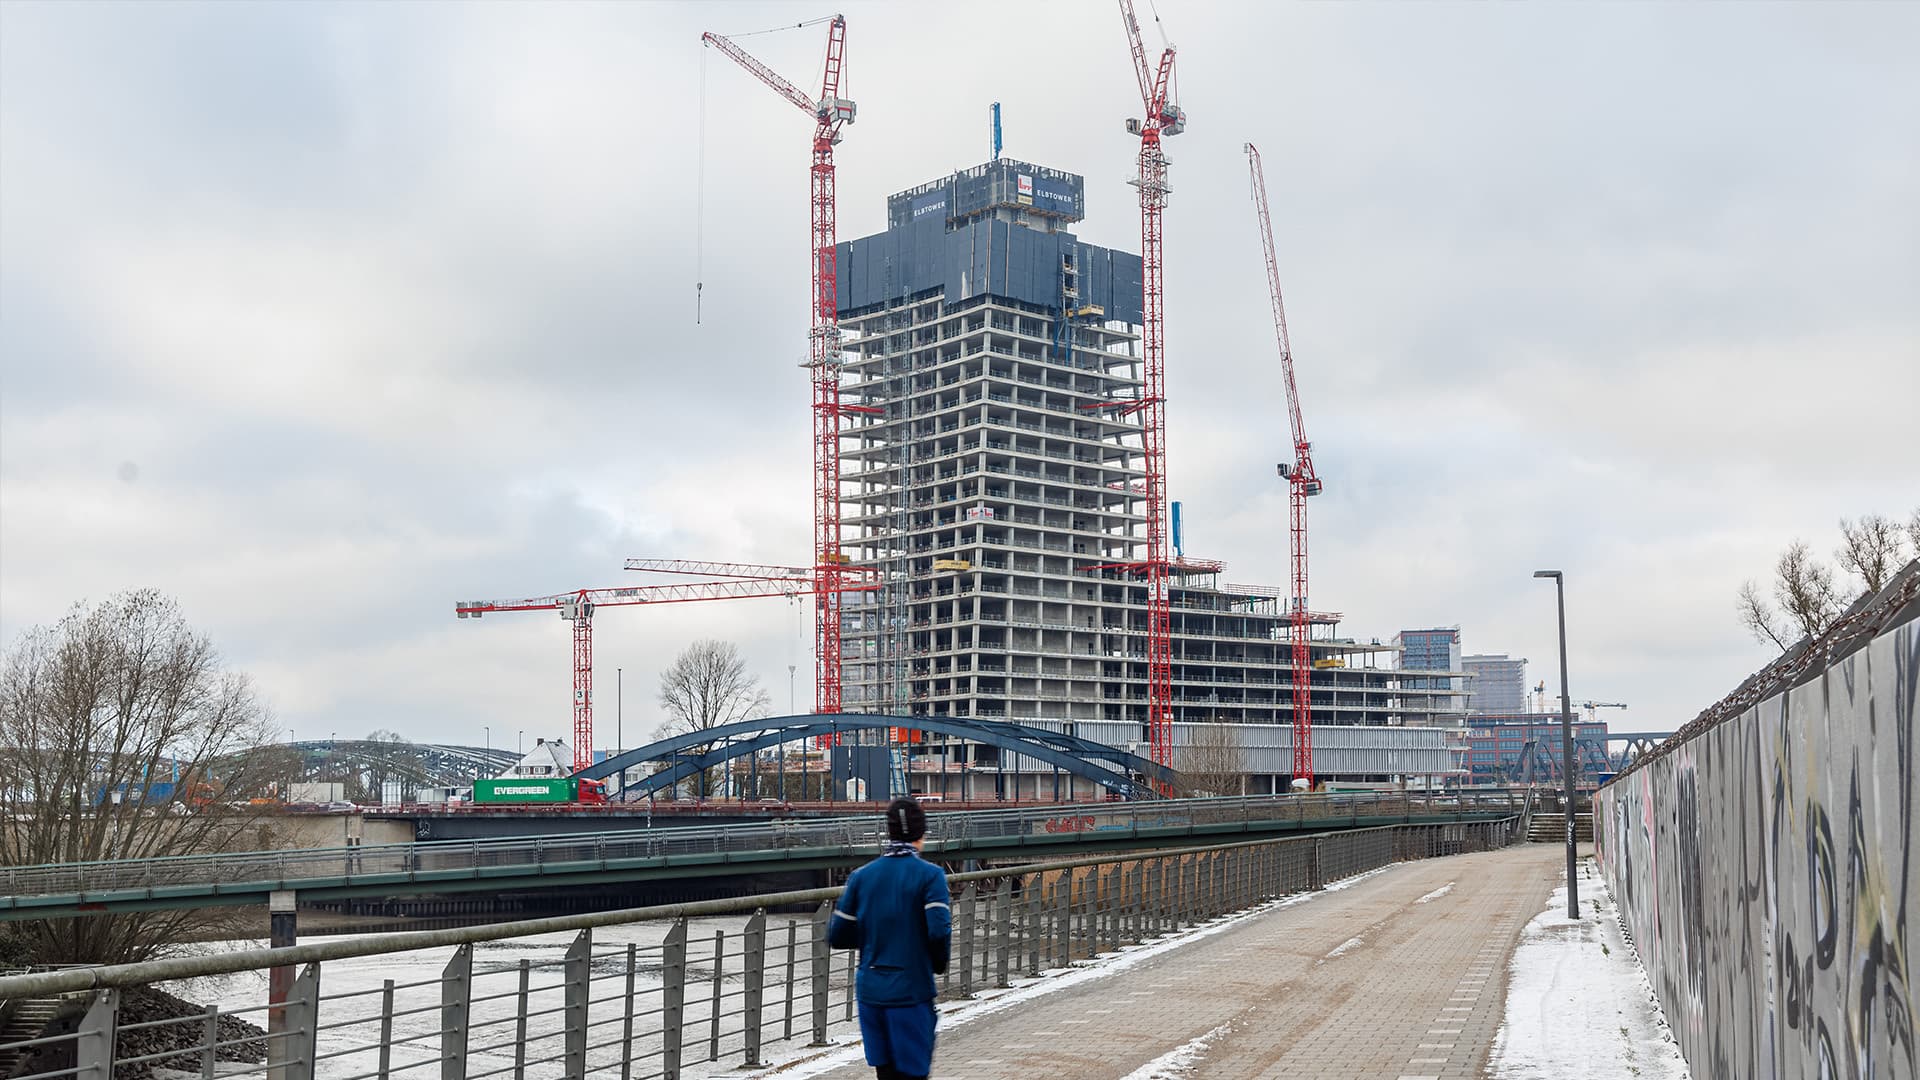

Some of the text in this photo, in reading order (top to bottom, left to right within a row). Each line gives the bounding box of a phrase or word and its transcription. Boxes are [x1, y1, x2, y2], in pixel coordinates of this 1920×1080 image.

[1037, 189, 1073, 203] ELBTOWER
[914, 201, 945, 217] ELBTOWER
[494, 786, 550, 795] EVERGREEN
